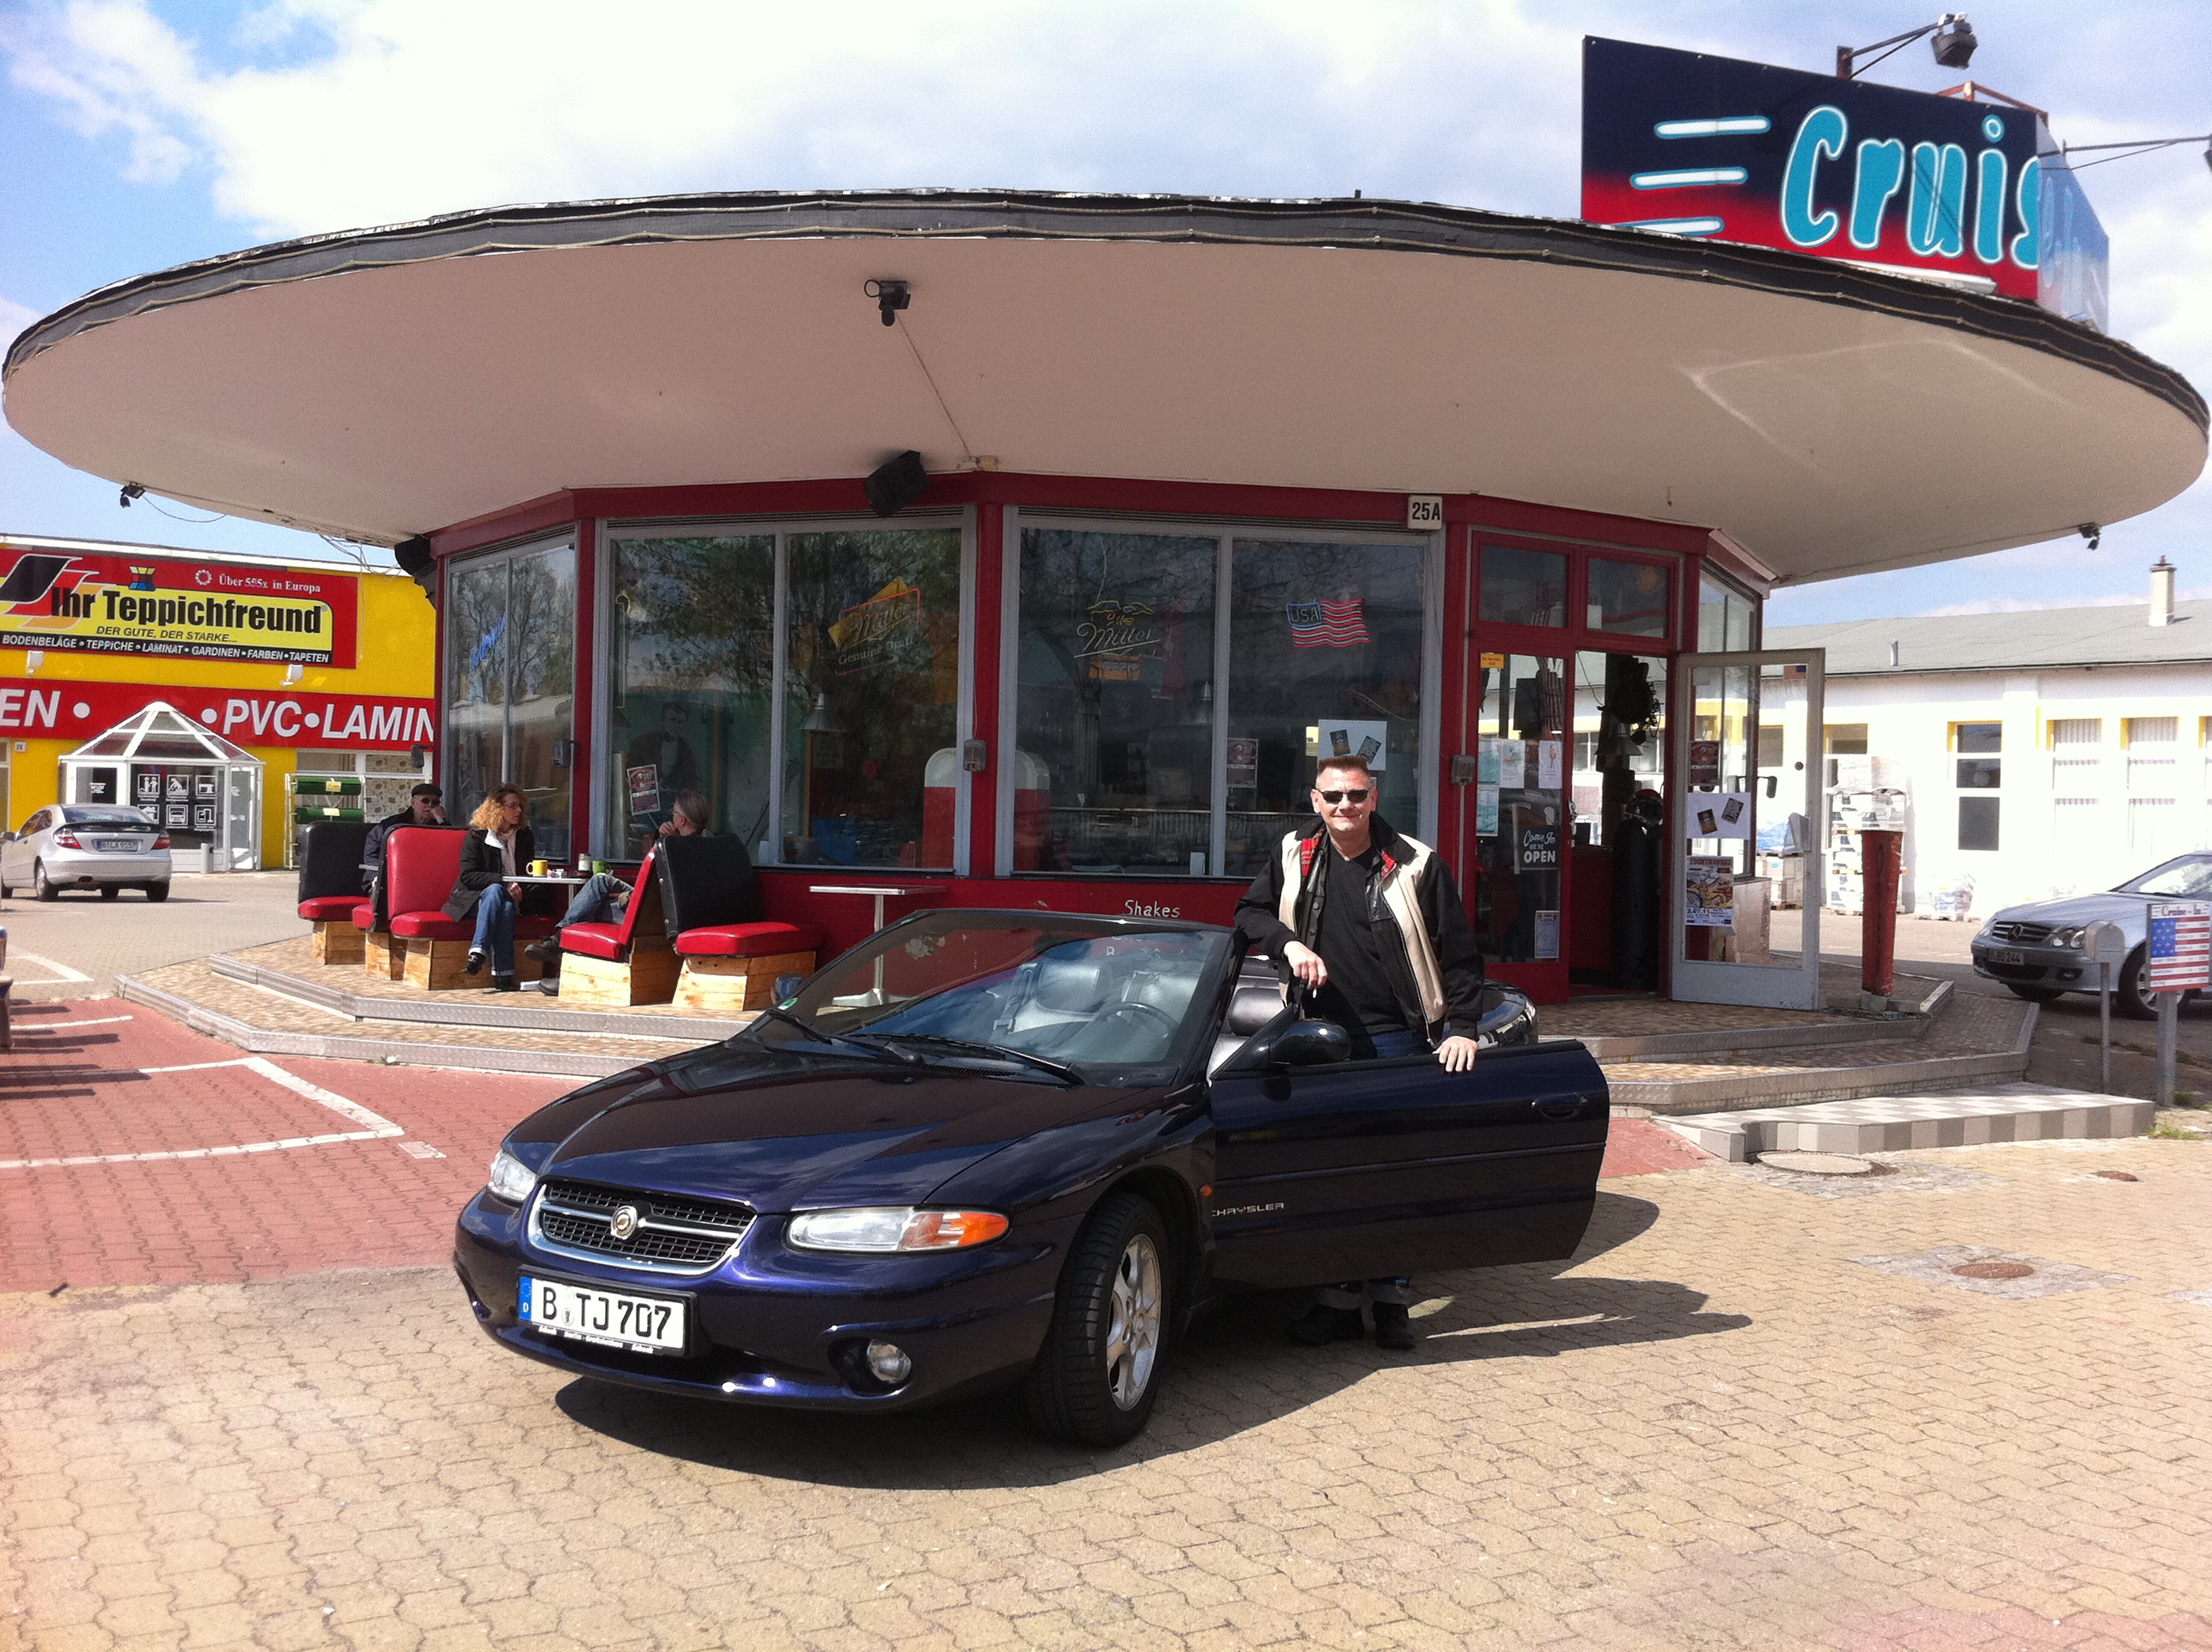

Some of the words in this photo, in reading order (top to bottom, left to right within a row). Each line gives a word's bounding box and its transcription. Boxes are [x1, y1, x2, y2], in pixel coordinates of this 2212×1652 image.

[1412, 502, 1441, 521] 25A
[218, 573, 244, 587] Über
[272, 581, 282, 590] in
[285, 580, 322, 595] Europa
[51, 587, 96, 618] Ihr
[102, 590, 322, 634] Teppichfreund
[1290, 607, 1319, 623] USA
[96, 626, 121, 636] DER
[160, 630, 183, 639] DER
[1077, 622, 1154, 652] Miller
[3, 635, 77, 649] BODENBELÄGE
[86, 639, 134, 651] TEPPICHE
[143, 643, 183, 654] LAMINAT
[192, 646, 241, 658] GARDINEN
[247, 649, 283, 660] FARBEN
[289, 651, 329, 663] TAPETEN
[0, 689, 61, 728] EN
[223, 699, 302, 737] PVC
[321, 703, 434, 742] LAMIN
[1523, 829, 1545, 847] Come
[1523, 851, 1556, 863] OPEN
[1125, 899, 1180, 918] Shakes
[543, 1287, 557, 1320] B
[576, 1293, 609, 1331] TJ
[618, 1300, 672, 1340] 707
